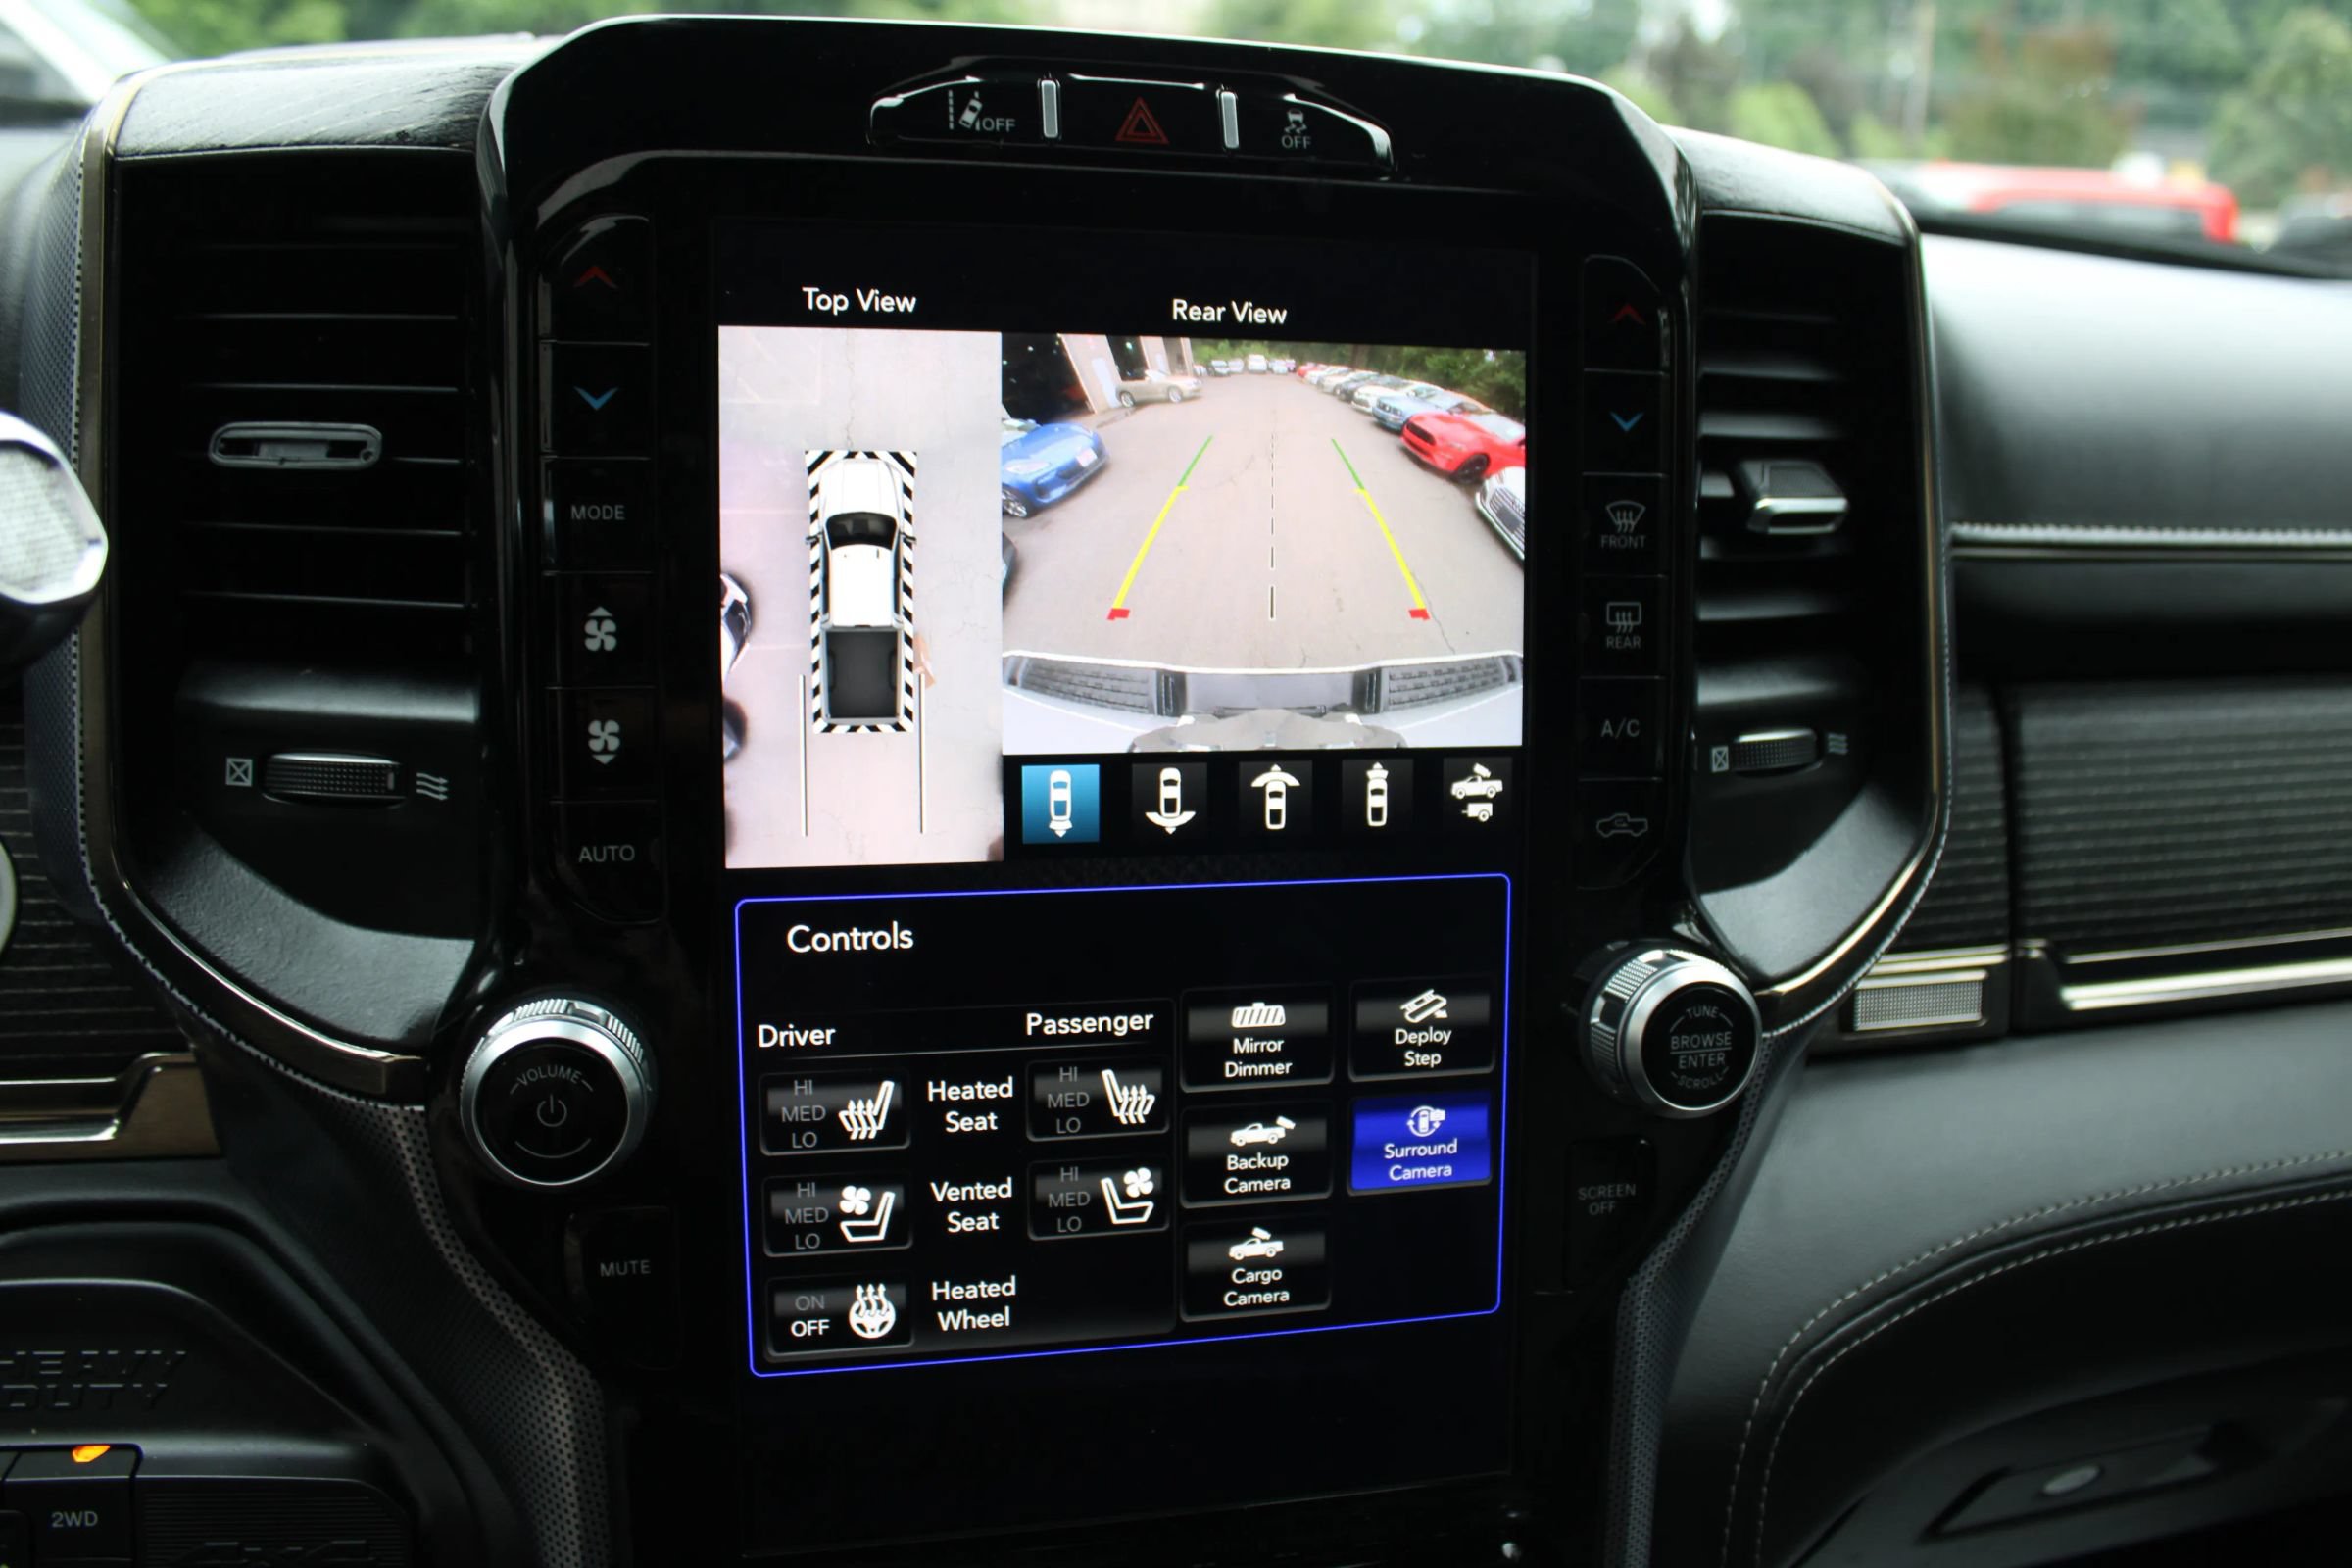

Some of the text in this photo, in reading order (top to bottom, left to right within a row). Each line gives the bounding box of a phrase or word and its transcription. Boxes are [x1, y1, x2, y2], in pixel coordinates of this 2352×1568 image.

[982, 118, 1015, 132] OFF
[1281, 135, 1311, 149] OFF
[803, 287, 916, 315] Top View
[1173, 299, 1287, 323] Rear View
[571, 505, 624, 519] MODE
[1600, 535, 1646, 550] FRONT
[1606, 636, 1642, 650] REAR
[1601, 719, 1639, 737] A/C
[579, 845, 635, 862] AUTO
[787, 921, 913, 953] Controls
[1686, 1004, 1720, 1019] TUNE
[1027, 1013, 1153, 1036] Passenger
[759, 1024, 836, 1047] Driver
[1396, 1026, 1451, 1046] Deploy
[1670, 1031, 1732, 1050] BROWSE
[1234, 1038, 1284, 1054] Mirror
[1405, 1051, 1441, 1067] Step
[1678, 1052, 1726, 1070] ENTER
[517, 1064, 582, 1087] VOLUME
[1058, 1066, 1079, 1082] HI
[1225, 1061, 1292, 1077] Dimmer
[793, 1079, 813, 1096] HI
[928, 1076, 1013, 1101] Heated
[1048, 1092, 1089, 1106] MED
[782, 1105, 825, 1120] MED
[946, 1111, 998, 1132] Seat
[1056, 1117, 1082, 1135] LO
[791, 1132, 818, 1150] LO
[1383, 1138, 1458, 1160] Surround
[1227, 1152, 1289, 1170] Backup
[1059, 1166, 1080, 1182] HI
[1388, 1163, 1453, 1182] Camera
[796, 1181, 816, 1198] HI
[931, 1177, 1012, 1201] Vented
[1224, 1177, 1290, 1194] Camera
[1578, 1183, 1637, 1201] SCREEN
[1049, 1192, 1090, 1206] MED
[786, 1207, 828, 1222] MED
[1589, 1201, 1617, 1216] OFF
[948, 1211, 999, 1233] Seat
[1056, 1216, 1083, 1233] LO
[794, 1233, 821, 1250] LO
[601, 1260, 649, 1276] MUTE
[1231, 1268, 1284, 1289] Cargo
[932, 1275, 1015, 1300] Heated
[795, 1295, 825, 1311] ON
[1224, 1290, 1291, 1308] Camera
[938, 1306, 1009, 1331] Wheel
[791, 1319, 830, 1337] OFF
[52, 1511, 97, 1528] 2WD
